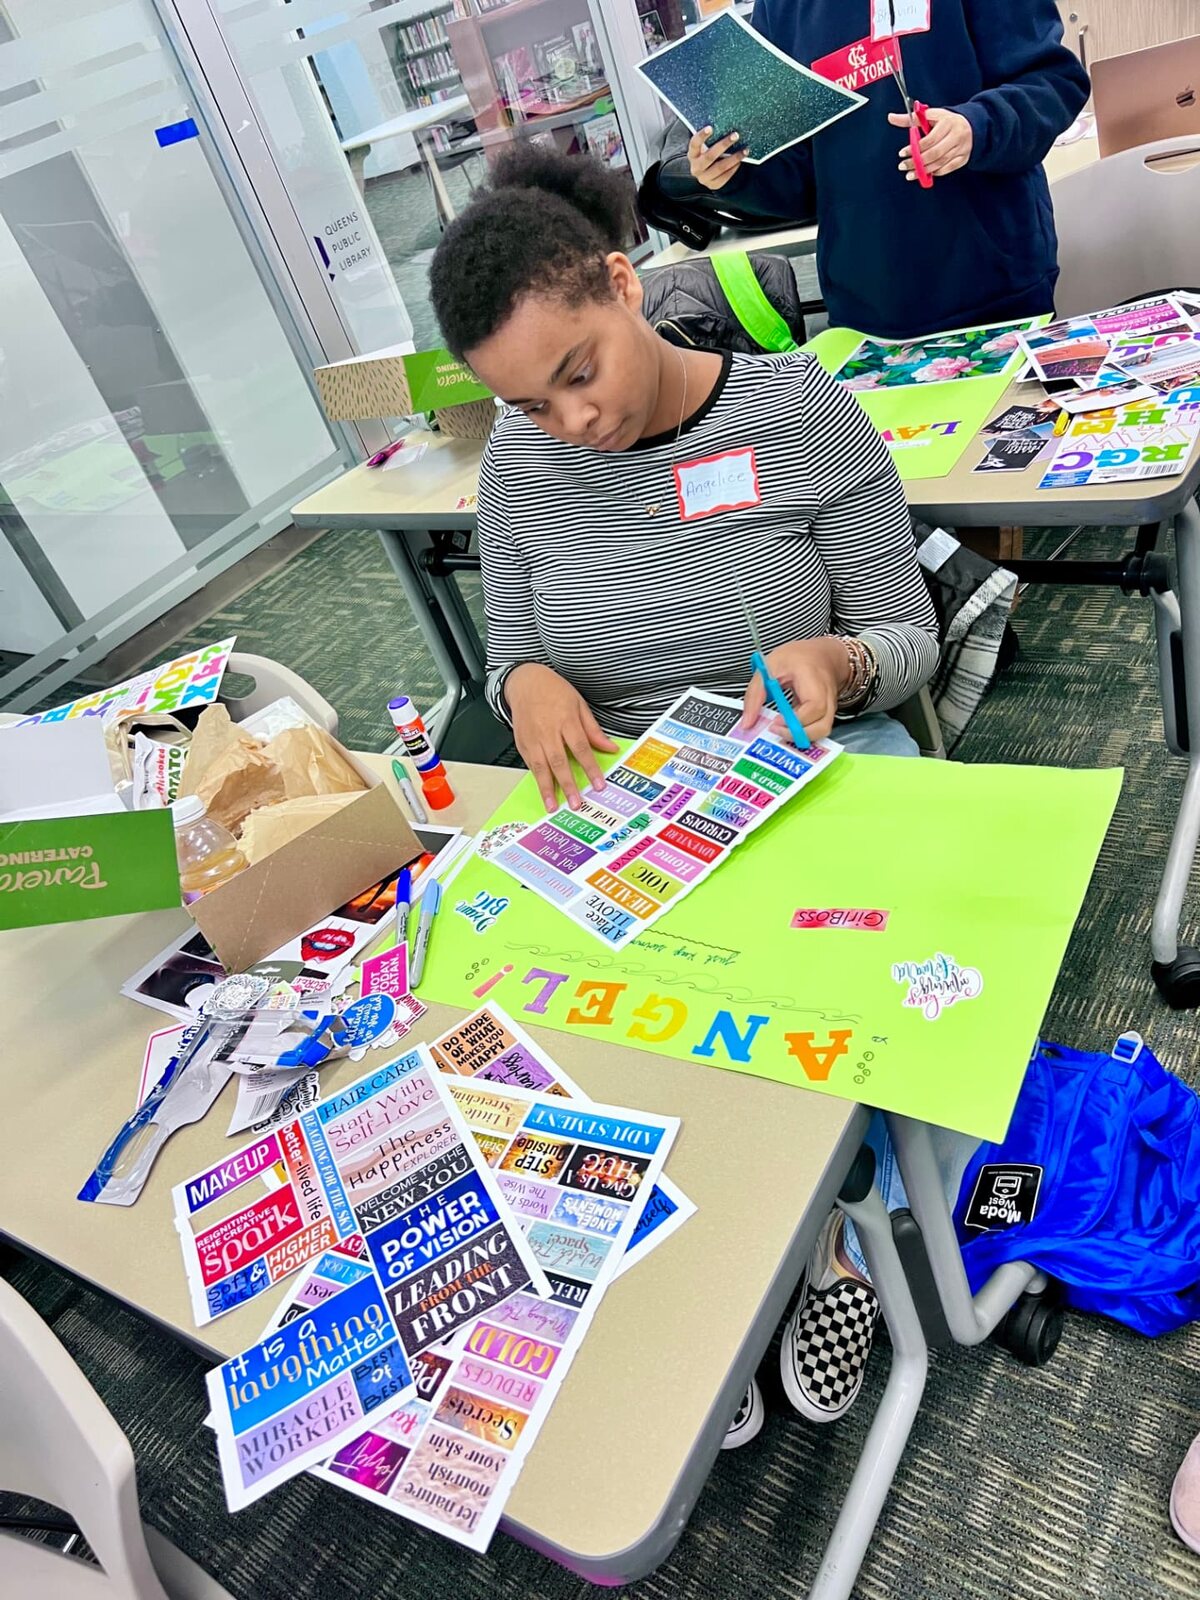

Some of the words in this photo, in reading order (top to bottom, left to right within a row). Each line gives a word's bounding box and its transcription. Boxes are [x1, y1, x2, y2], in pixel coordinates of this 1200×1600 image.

[860, 55, 895, 84] YORK
[324, 211, 359, 236] QUEENS
[331, 231, 361, 254] PUBLIC
[339, 246, 371, 272] LIBRARY
[678, 708, 706, 728] YOUR
[684, 700, 738, 723] PURPOSE
[704, 717, 730, 736] FIND
[752, 743, 804, 775] SWITCH
[609, 769, 645, 793] CARE
[761, 777, 787, 796] BOLD
[554, 811, 579, 832] BYE
[706, 795, 757, 820] PROJECTS
[577, 823, 602, 842] BYE
[665, 828, 718, 858] ADVENTURE
[684, 814, 733, 843] CURIOUS
[656, 848, 695, 876] Home
[475, 891, 510, 915] BIG
[595, 871, 653, 916] HEALTH
[584, 912, 614, 937] Place
[586, 896, 622, 926] LOVE
[797, 910, 884, 927] GirlBoss
[379, 960, 391, 993] ODAY
[441, 1036, 460, 1051] DO
[459, 1012, 491, 1036] MORE
[450, 1044, 465, 1060] OF
[465, 1021, 496, 1048] WHAT
[485, 1028, 505, 1046] YOU
[470, 1040, 506, 1071] HAPPY
[323, 1085, 368, 1121] HAIR
[371, 1056, 419, 1091] CARE
[327, 1107, 373, 1138] Start
[376, 1077, 426, 1111] With
[335, 1088, 434, 1154] Self-Love
[465, 1108, 503, 1128] Little
[372, 1129, 417, 1158] The
[532, 1109, 660, 1147] ADJUSTMENT
[349, 1122, 452, 1190] Happiness
[402, 1133, 459, 1172] EXPLORER
[514, 1153, 554, 1174] STEP
[516, 1136, 568, 1161] Outside
[190, 1143, 270, 1206] MAKEUP
[302, 1113, 325, 1163] REACHING
[335, 1209, 355, 1237] SKY
[355, 1174, 420, 1214] WELCOME
[417, 1163, 439, 1181] TO
[440, 1145, 465, 1168] THE
[578, 1173, 599, 1190] Us
[582, 1152, 640, 1181] HUG
[361, 1190, 417, 1231] NEW
[423, 1157, 468, 1194] YOU
[502, 1178, 528, 1197] Wise
[529, 1185, 548, 1200] The
[600, 1178, 636, 1199] Give
[307, 1198, 323, 1222] life
[402, 1193, 447, 1226] THE
[519, 1195, 550, 1216] Words
[562, 1195, 623, 1223] MOMENTS
[979, 1204, 1022, 1224] Moda
[988, 1197, 1017, 1211] West
[196, 1209, 256, 1250] REIGNITING
[200, 1236, 223, 1255] THE
[221, 1209, 272, 1243] CREATIVE
[381, 1190, 482, 1263] POWER
[576, 1211, 619, 1234] ANGEL
[203, 1202, 298, 1277] spark
[268, 1218, 332, 1267] HIGHER
[387, 1251, 416, 1280] OF
[418, 1208, 490, 1260] VISION
[549, 1230, 590, 1254] Space!
[272, 1235, 331, 1280] POWER
[394, 1230, 509, 1317] LEADING
[207, 1272, 252, 1301] Soft
[249, 1263, 266, 1283] &
[210, 1279, 267, 1314] SWEET
[419, 1279, 464, 1313] FROM
[463, 1261, 494, 1285] THE
[411, 1263, 512, 1343] FRONT
[228, 1354, 251, 1384] it
[260, 1335, 286, 1364] is
[298, 1317, 318, 1341] a
[306, 1320, 391, 1388] Matter
[354, 1347, 397, 1381] BEST
[469, 1326, 557, 1376] GOLD
[364, 1373, 407, 1412] BEST
[463, 1364, 538, 1402] REDUCES
[239, 1379, 353, 1461] MIRACLE
[448, 1395, 519, 1442] Secrets
[242, 1401, 356, 1477] WORKER
[428, 1434, 463, 1455] skin
[463, 1449, 507, 1474] your
[428, 1461, 492, 1498] nourish
[403, 1481, 458, 1516] nature
[458, 1506, 482, 1530] let
